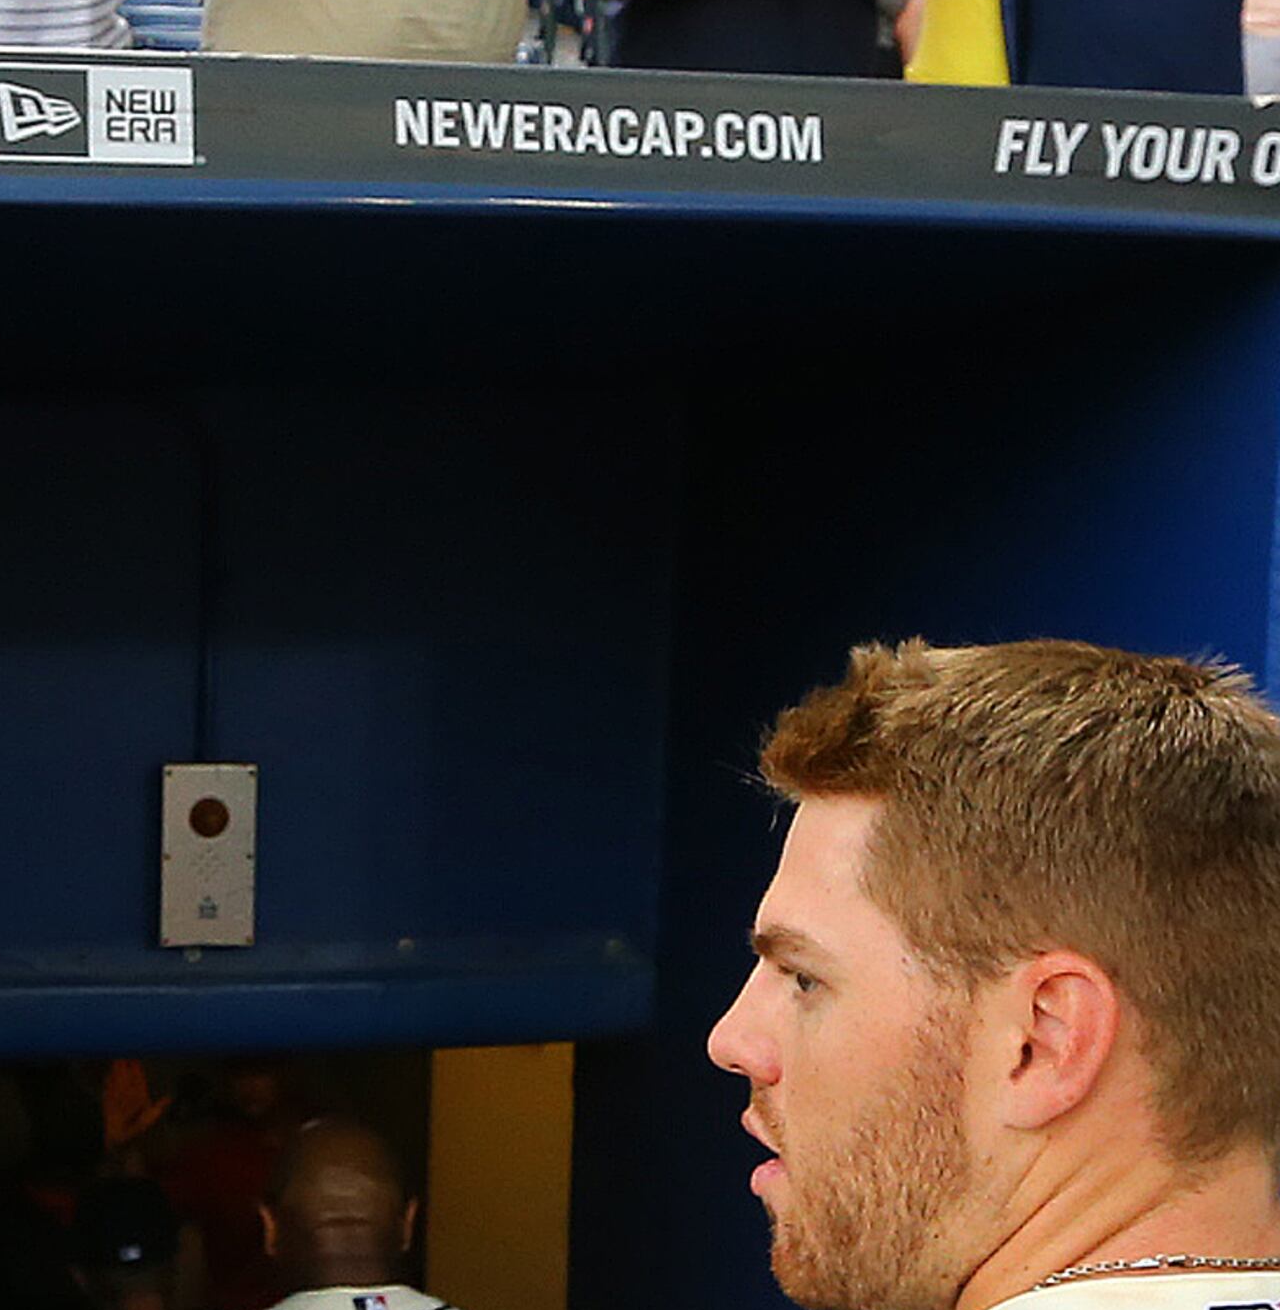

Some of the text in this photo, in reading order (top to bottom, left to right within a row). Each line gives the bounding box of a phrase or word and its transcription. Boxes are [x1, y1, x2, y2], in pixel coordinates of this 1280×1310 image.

[105, 89, 176, 115] NEW
[105, 117, 177, 144] ERA
[394, 98, 824, 163] NEWERACAP.COM
[994, 119, 1089, 177] FLY
[1102, 123, 1241, 185] YOUR
